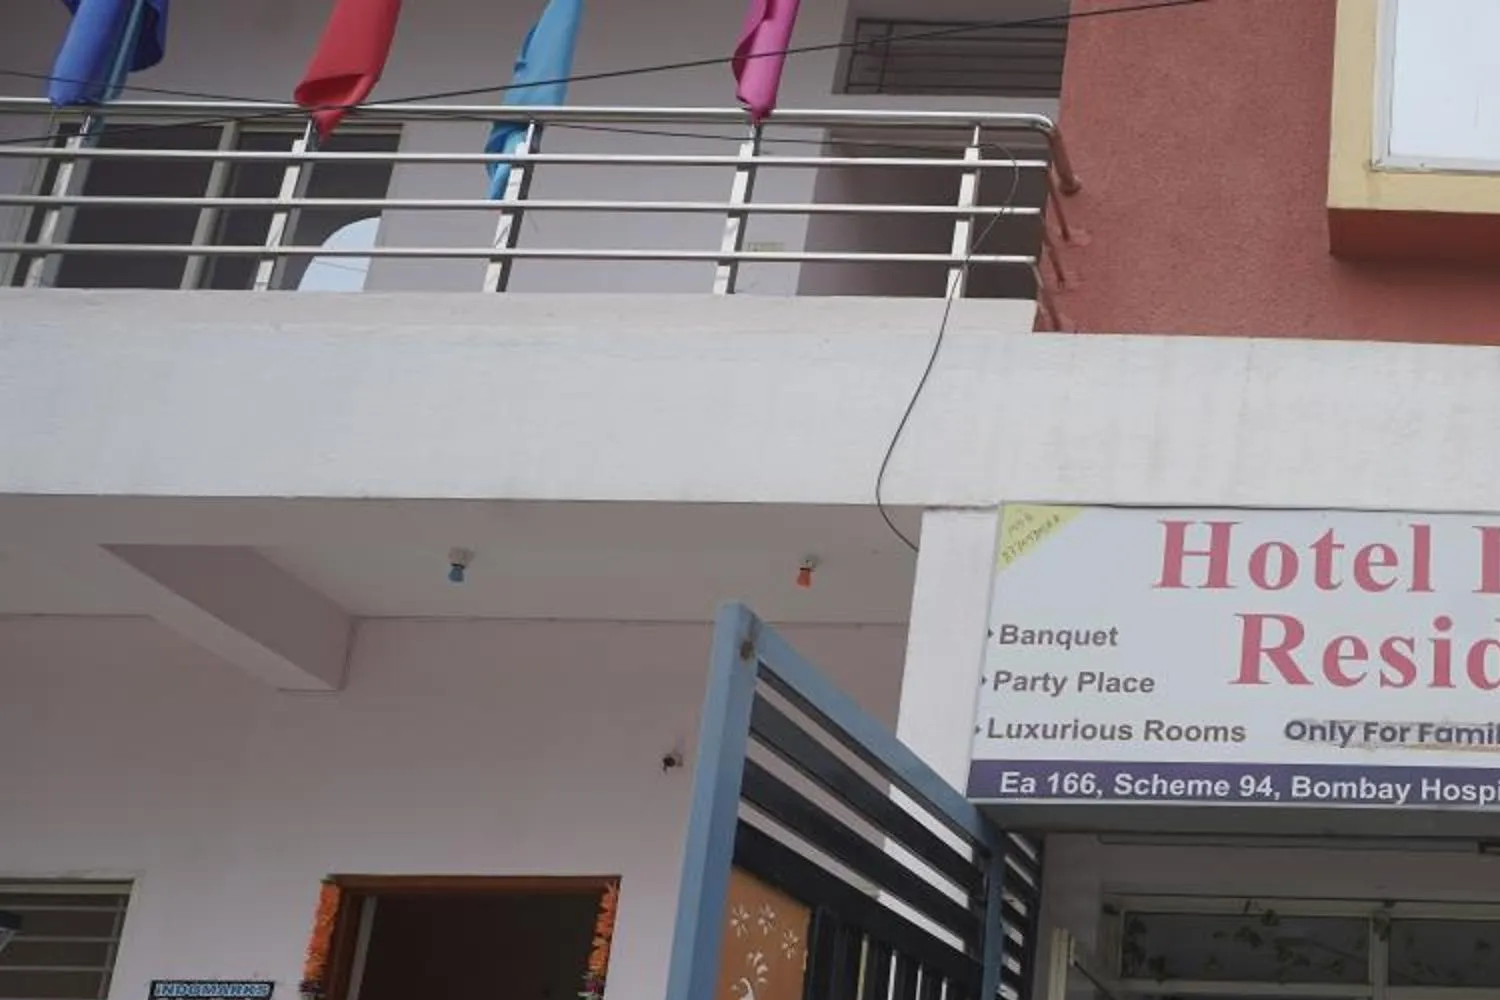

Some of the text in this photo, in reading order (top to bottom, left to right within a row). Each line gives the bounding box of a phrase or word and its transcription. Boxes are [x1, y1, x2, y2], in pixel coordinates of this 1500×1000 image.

[1152, 520, 1435, 593] Hotel
[999, 624, 1119, 650] Banquet
[993, 670, 1156, 697] Party Place
[987, 718, 1247, 743] Luxurious Rooms
[1284, 719, 1354, 748] Only
[1363, 721, 1410, 743] For
[1000, 771, 1036, 793] Ea
[1047, 772, 1103, 799] 166,
[1114, 774, 1231, 797] Scheme
[1239, 775, 1280, 801] 94,
[1291, 776, 1411, 805] Bombay
